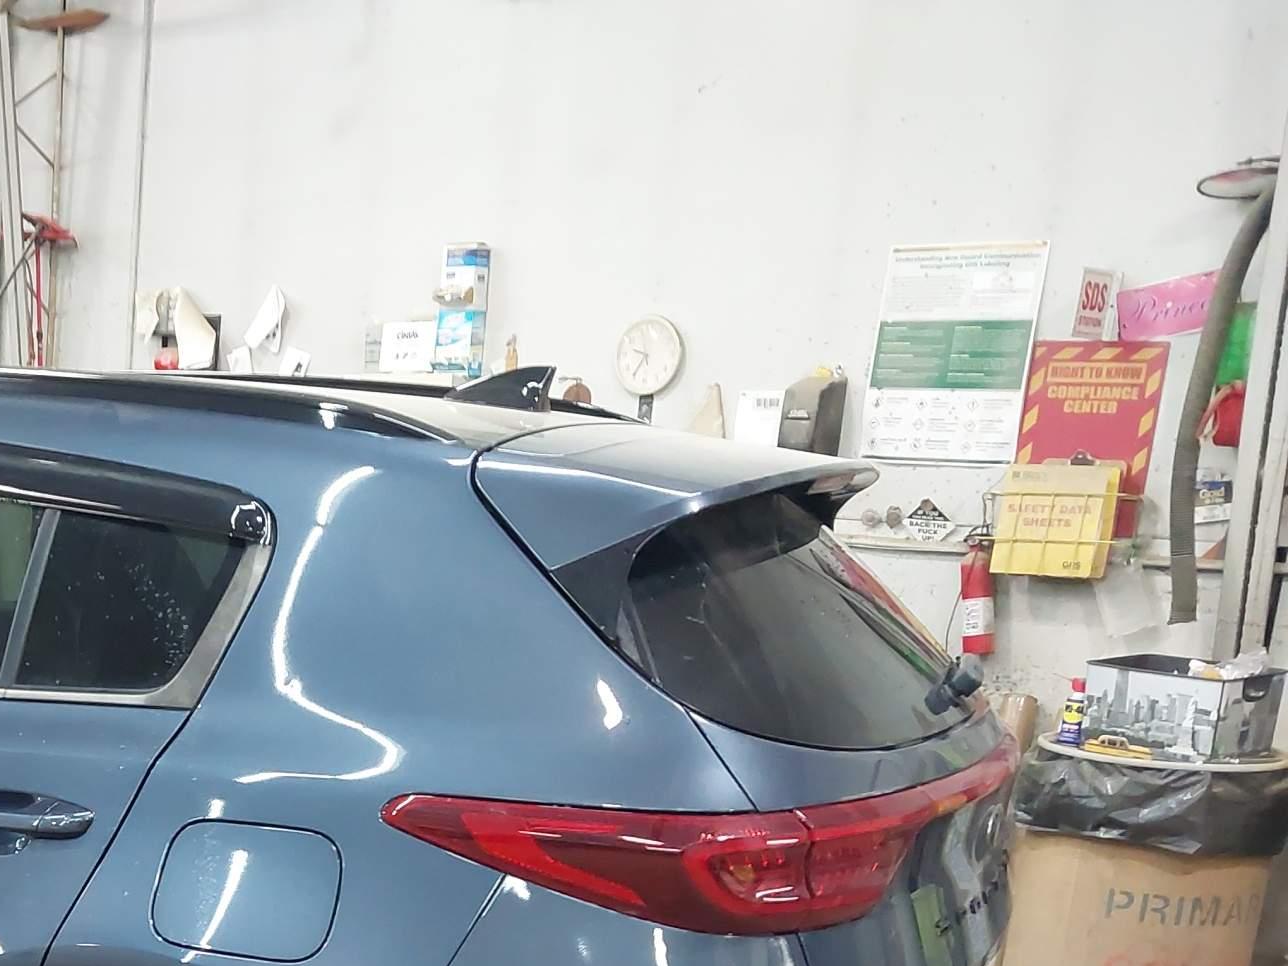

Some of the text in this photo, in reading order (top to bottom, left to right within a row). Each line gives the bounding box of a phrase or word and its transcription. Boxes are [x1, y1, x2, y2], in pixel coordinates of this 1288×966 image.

[1082, 280, 1108, 312] SDS
[1051, 365, 1143, 379] RIGHT TO KNOW
[1048, 385, 1140, 400] COMPLIANCE
[1064, 399, 1118, 414] CENTER
[1059, 504, 1091, 514] DATA
[1023, 517, 1071, 528] SHEETS
